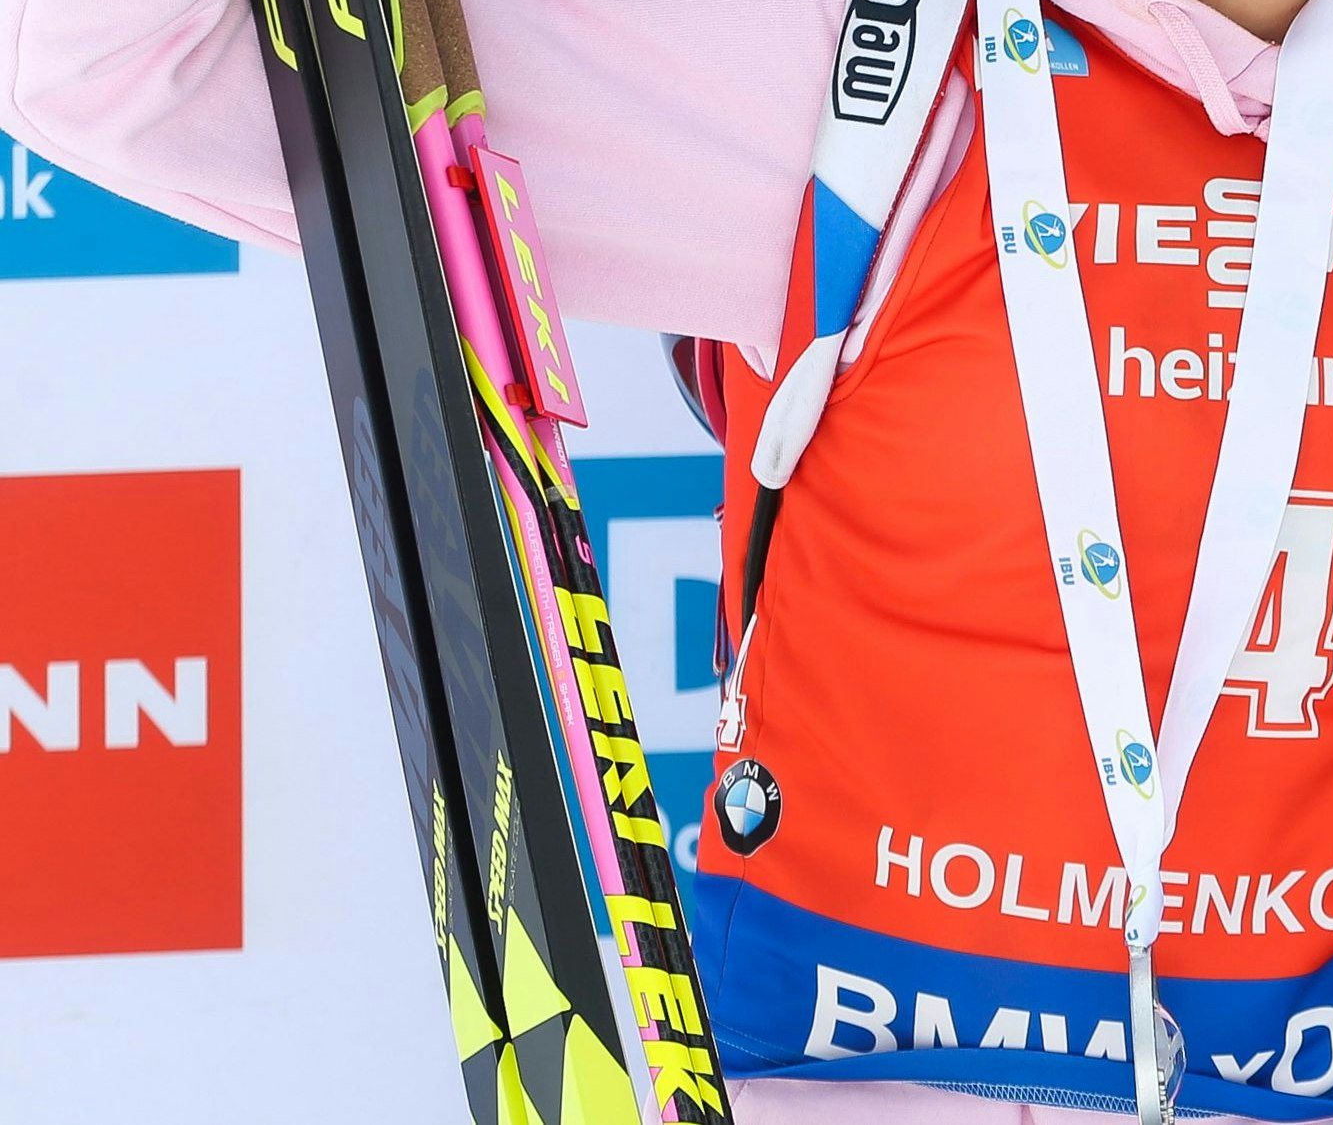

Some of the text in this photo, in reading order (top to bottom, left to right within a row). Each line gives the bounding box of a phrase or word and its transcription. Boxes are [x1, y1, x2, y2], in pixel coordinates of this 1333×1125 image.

[985, 36, 997, 63] IBU
[1002, 226, 1017, 254] IBU
[495, 171, 570, 405] LEKI
[1058, 557, 1075, 586] IBU
[543, 612, 563, 669] TRIGGER
[559, 681, 574, 726] SHARK
[722, 761, 780, 803] BMW
[1101, 757, 1117, 787] IBU
[487, 748, 512, 936] SPEED MAX
